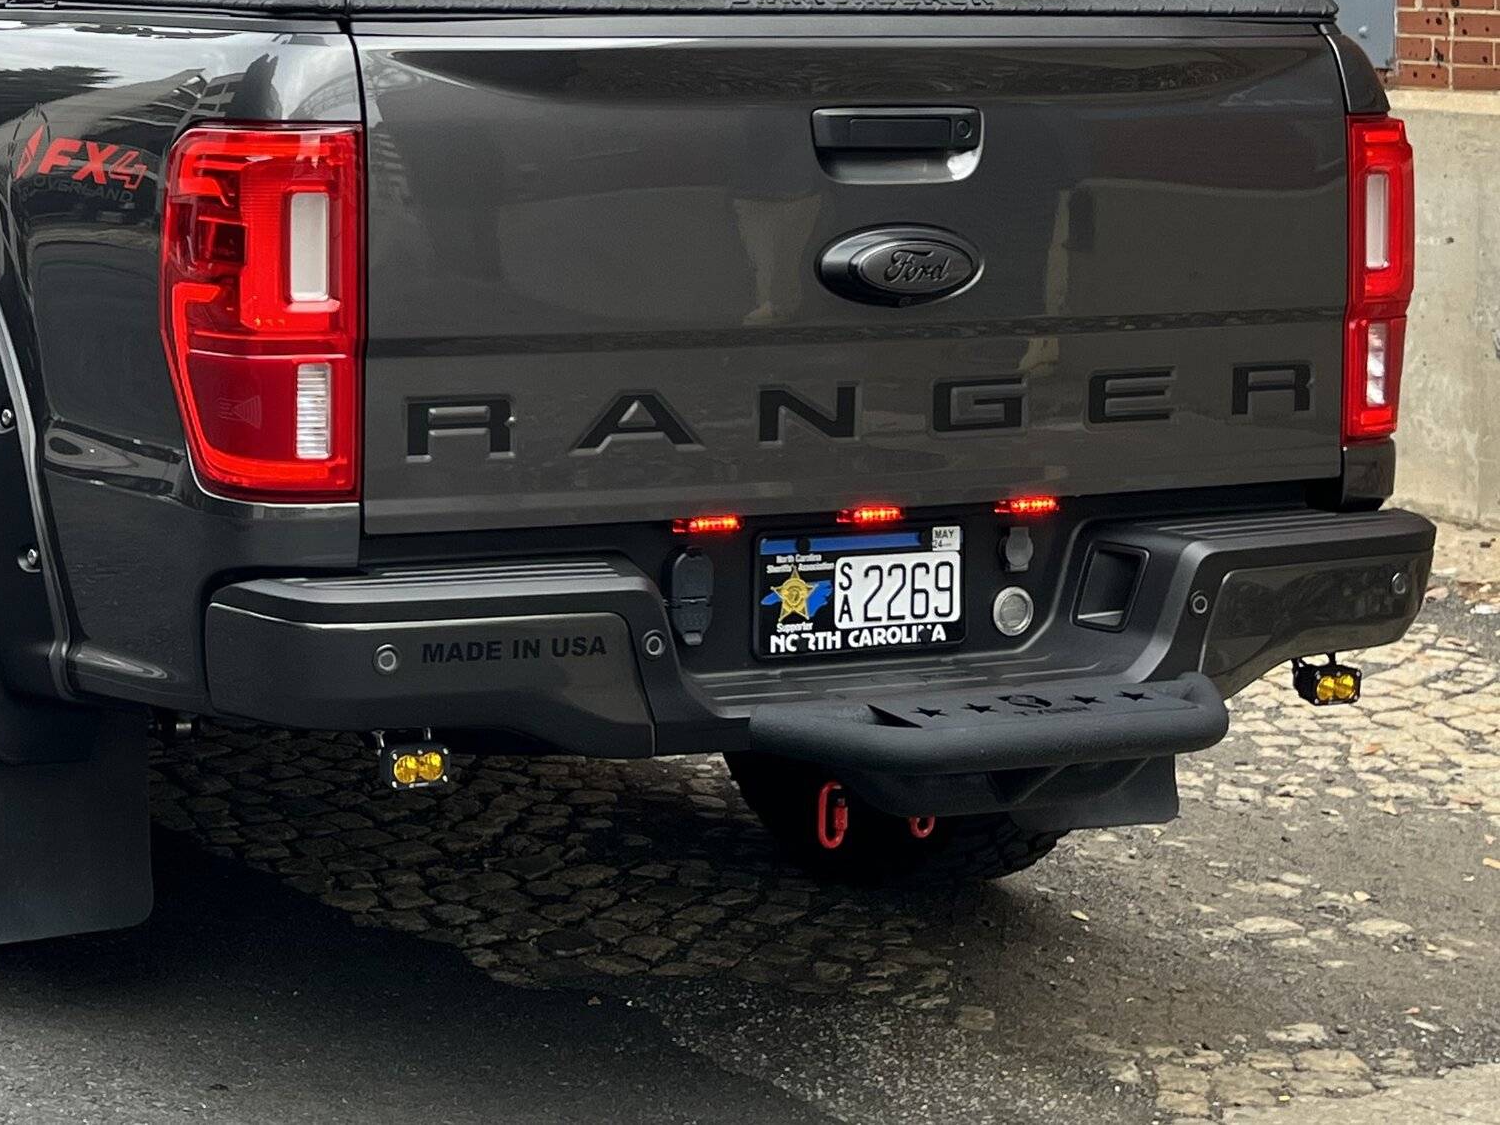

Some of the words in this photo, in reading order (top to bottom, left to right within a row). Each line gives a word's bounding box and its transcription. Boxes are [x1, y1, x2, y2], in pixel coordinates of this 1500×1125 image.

[37, 137, 149, 190] FX4
[883, 249, 951, 284] Ford
[405, 361, 1313, 462] RANGER
[934, 529, 955, 538] MAY
[864, 561, 954, 622] 2269
[421, 641, 502, 663] MADE
[512, 639, 541, 660] IN
[551, 636, 608, 658] USA
[847, 624, 947, 648] CAROLIA
